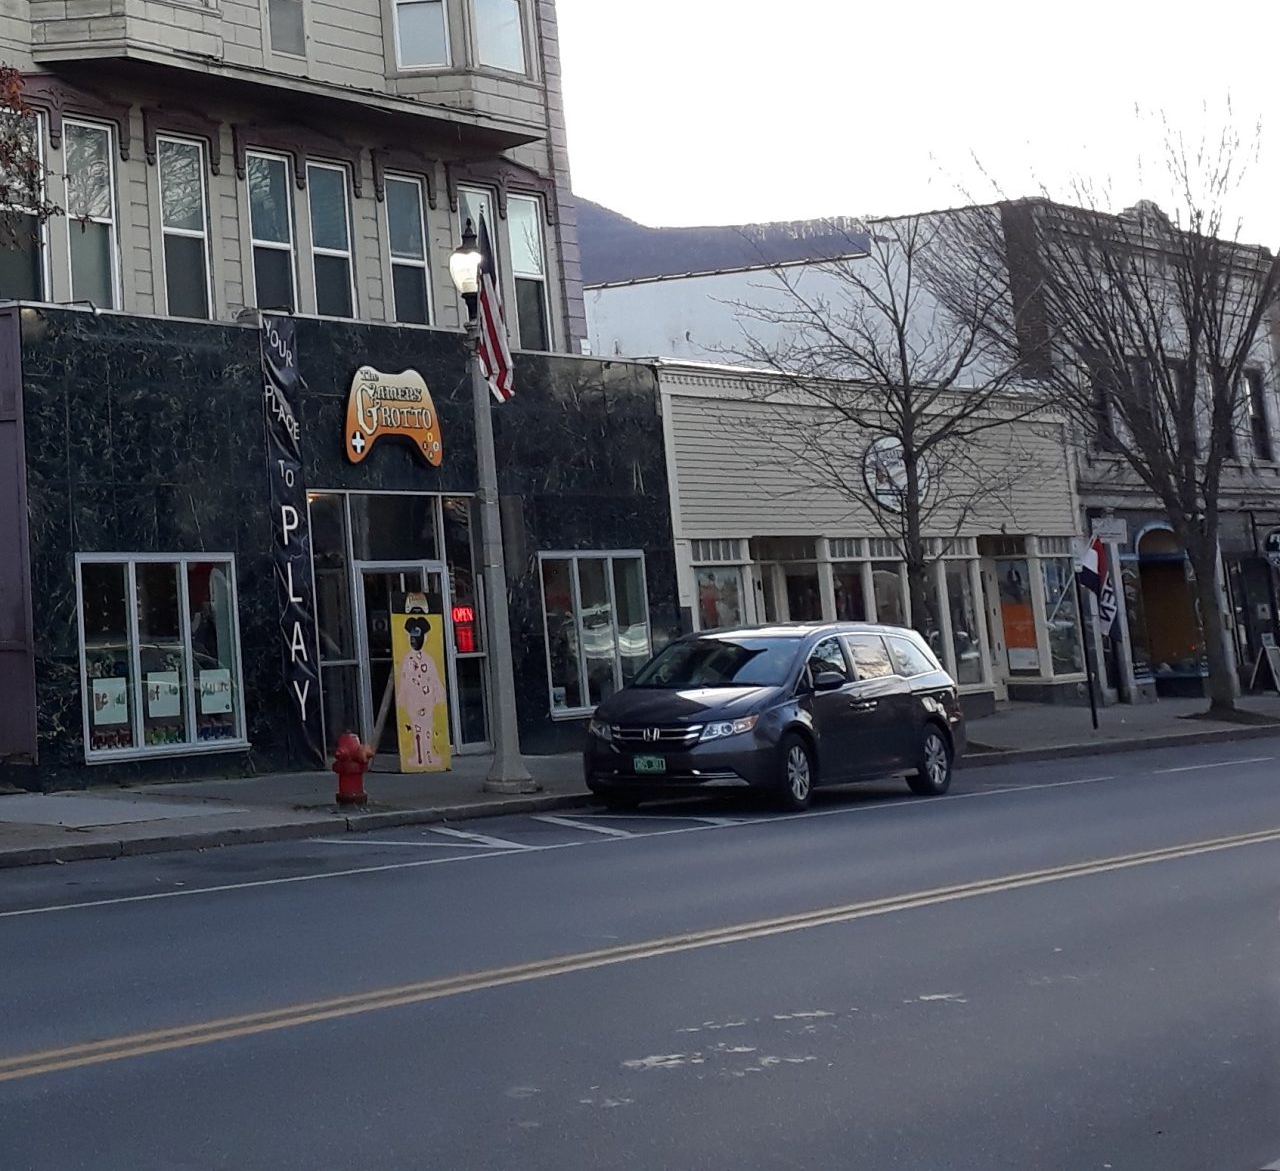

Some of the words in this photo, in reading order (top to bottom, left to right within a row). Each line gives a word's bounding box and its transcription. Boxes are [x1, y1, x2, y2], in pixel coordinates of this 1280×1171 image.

[264, 319, 293, 367] YOUR
[265, 385, 300, 440] PLACE
[278, 460, 295, 487] TO
[281, 504, 310, 722] PLAY
[452, 606, 474, 622] OPEN
